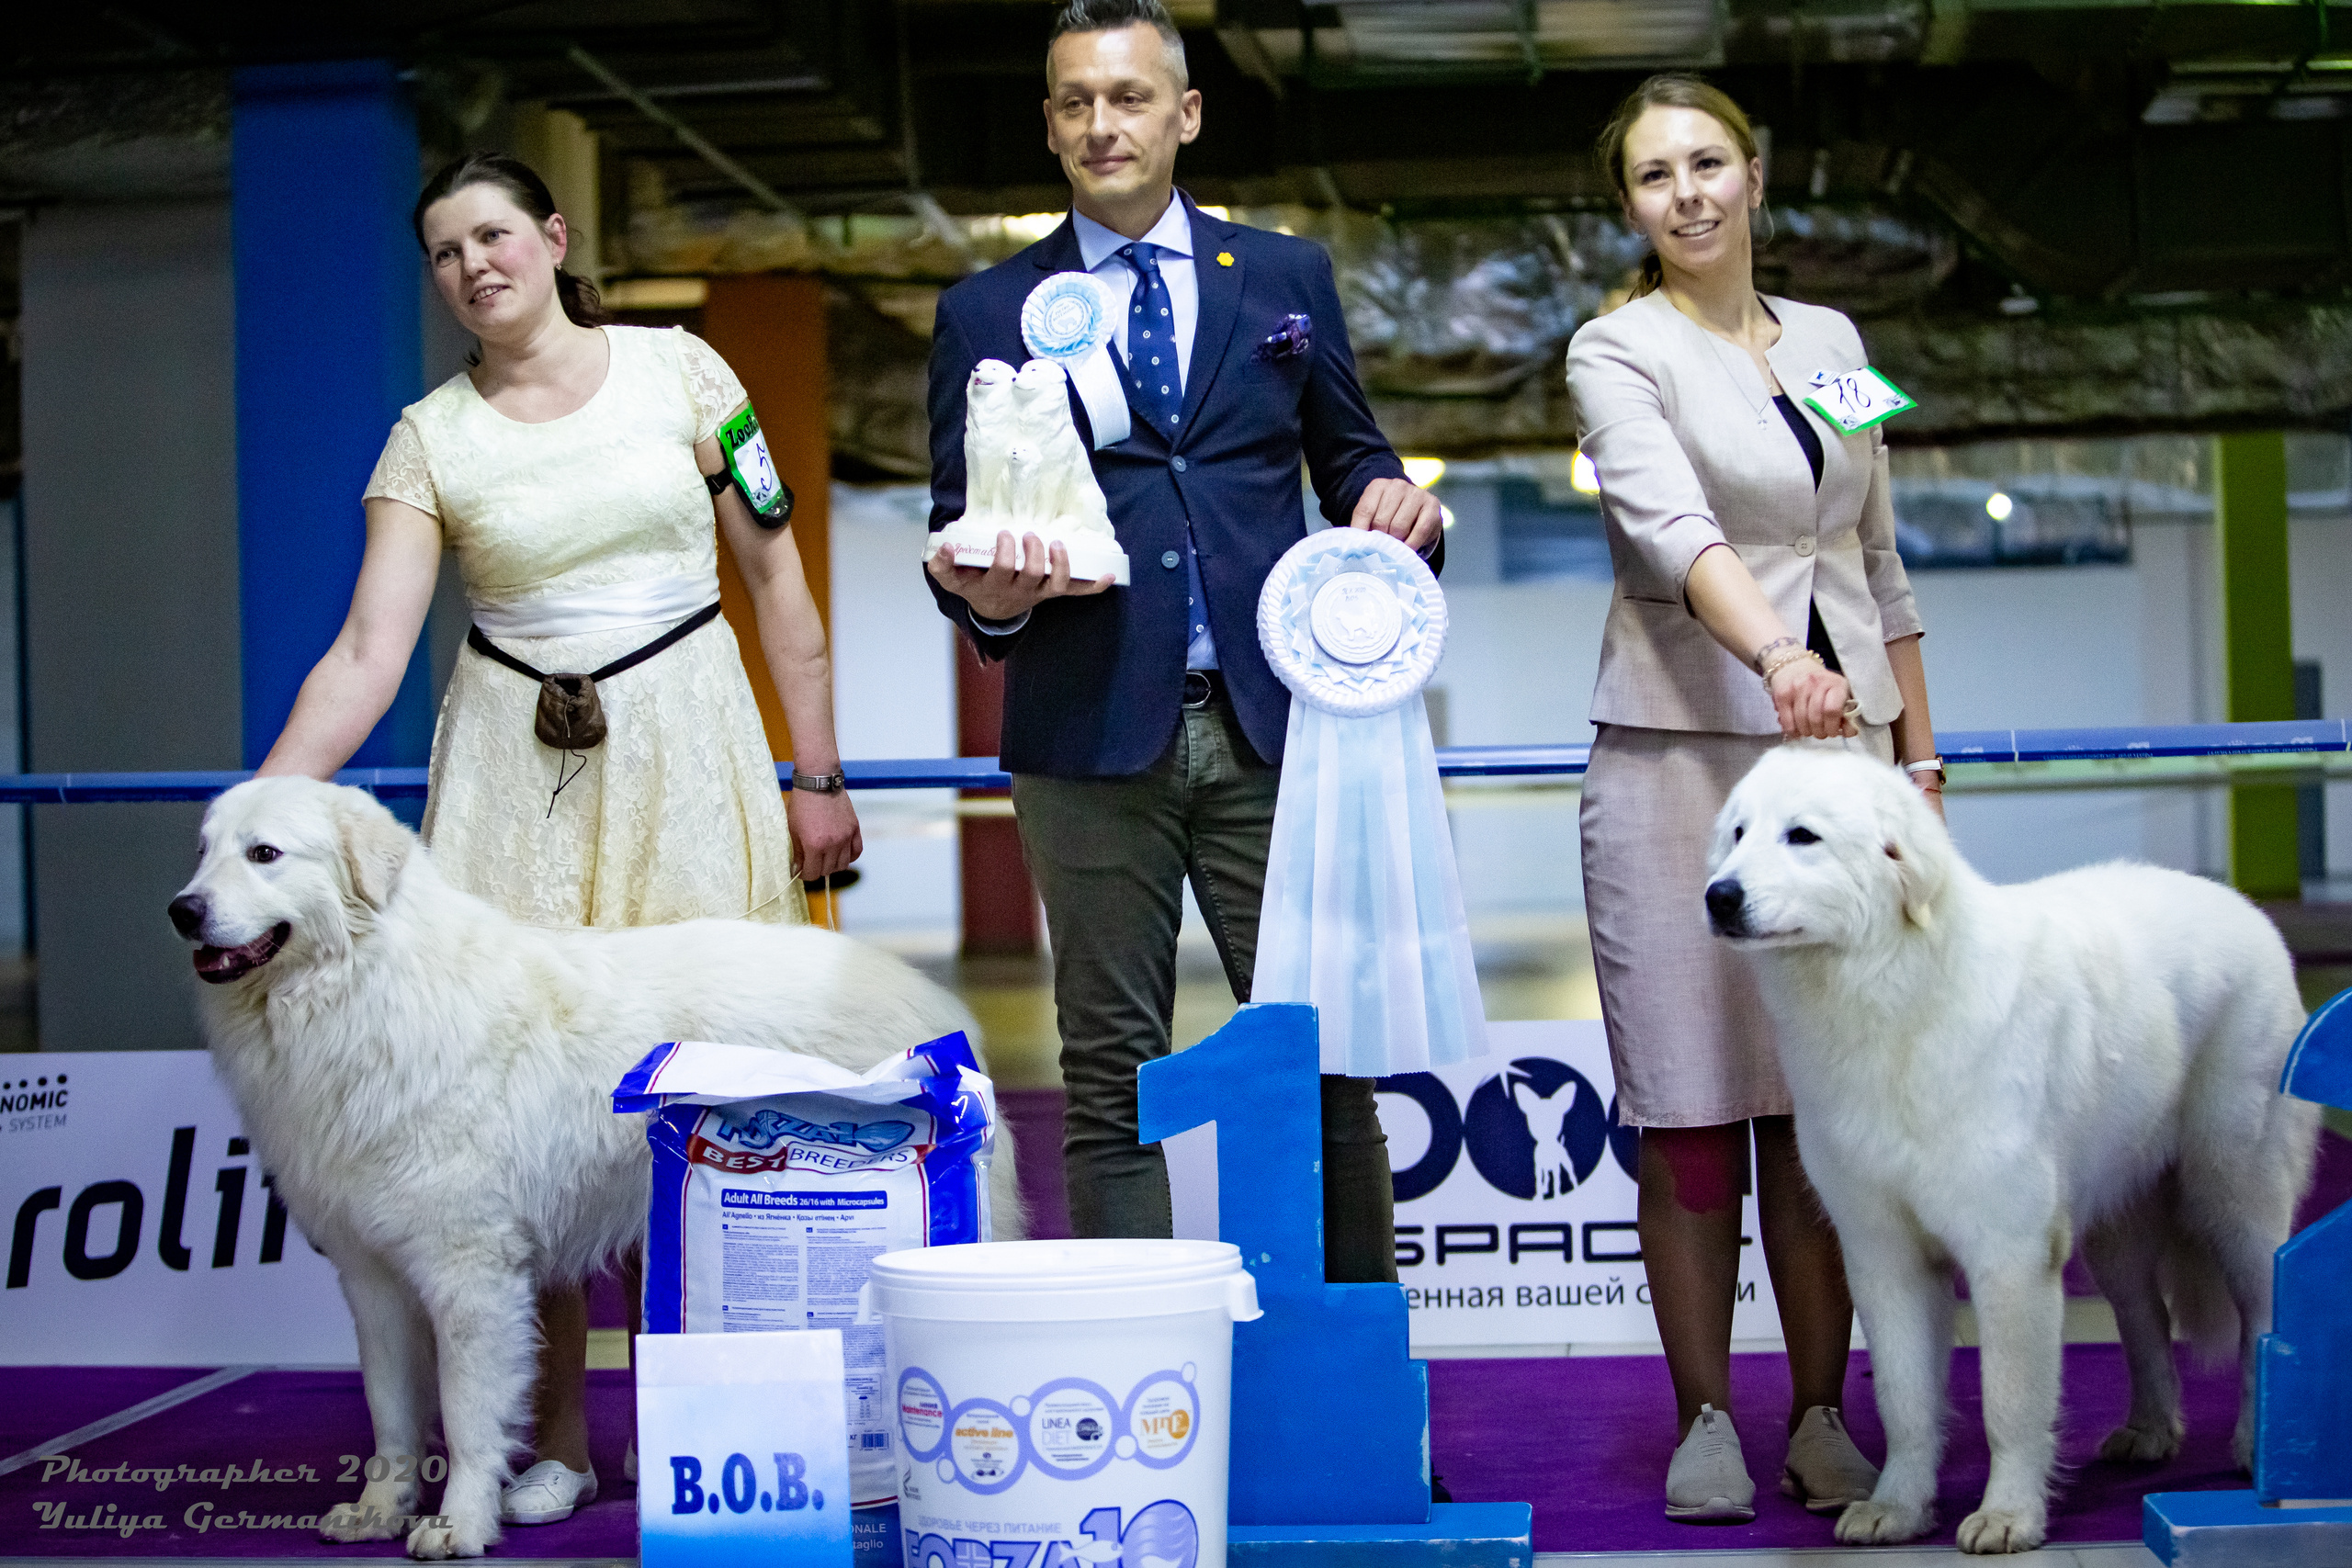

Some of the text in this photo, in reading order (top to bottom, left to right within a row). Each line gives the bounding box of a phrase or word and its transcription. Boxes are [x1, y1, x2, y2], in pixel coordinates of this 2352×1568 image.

[1837, 378, 1871, 413] 18
[755, 443, 773, 492] 5
[0, 1089, 68, 1114] NOMIC
[9, 1113, 67, 1134] SYSTEM
[702, 1145, 786, 1169] BEST
[723, 1191, 885, 1208] Adult All Breeds 26/16 with Microcapsules
[1395, 1221, 1753, 1267] SPAC
[1408, 1285, 1504, 1309] енная
[1516, 1276, 1625, 1307] вашей
[955, 1427, 1014, 1438] active line
[1041, 1416, 1071, 1429] LINEA
[1041, 1429, 1071, 1445] DIET
[670, 1451, 825, 1515] B.O.B.
[964, 1520, 1001, 1534] ЧЕРЕЗ
[1003, 1522, 1061, 1534] ПИТАНИЕ
